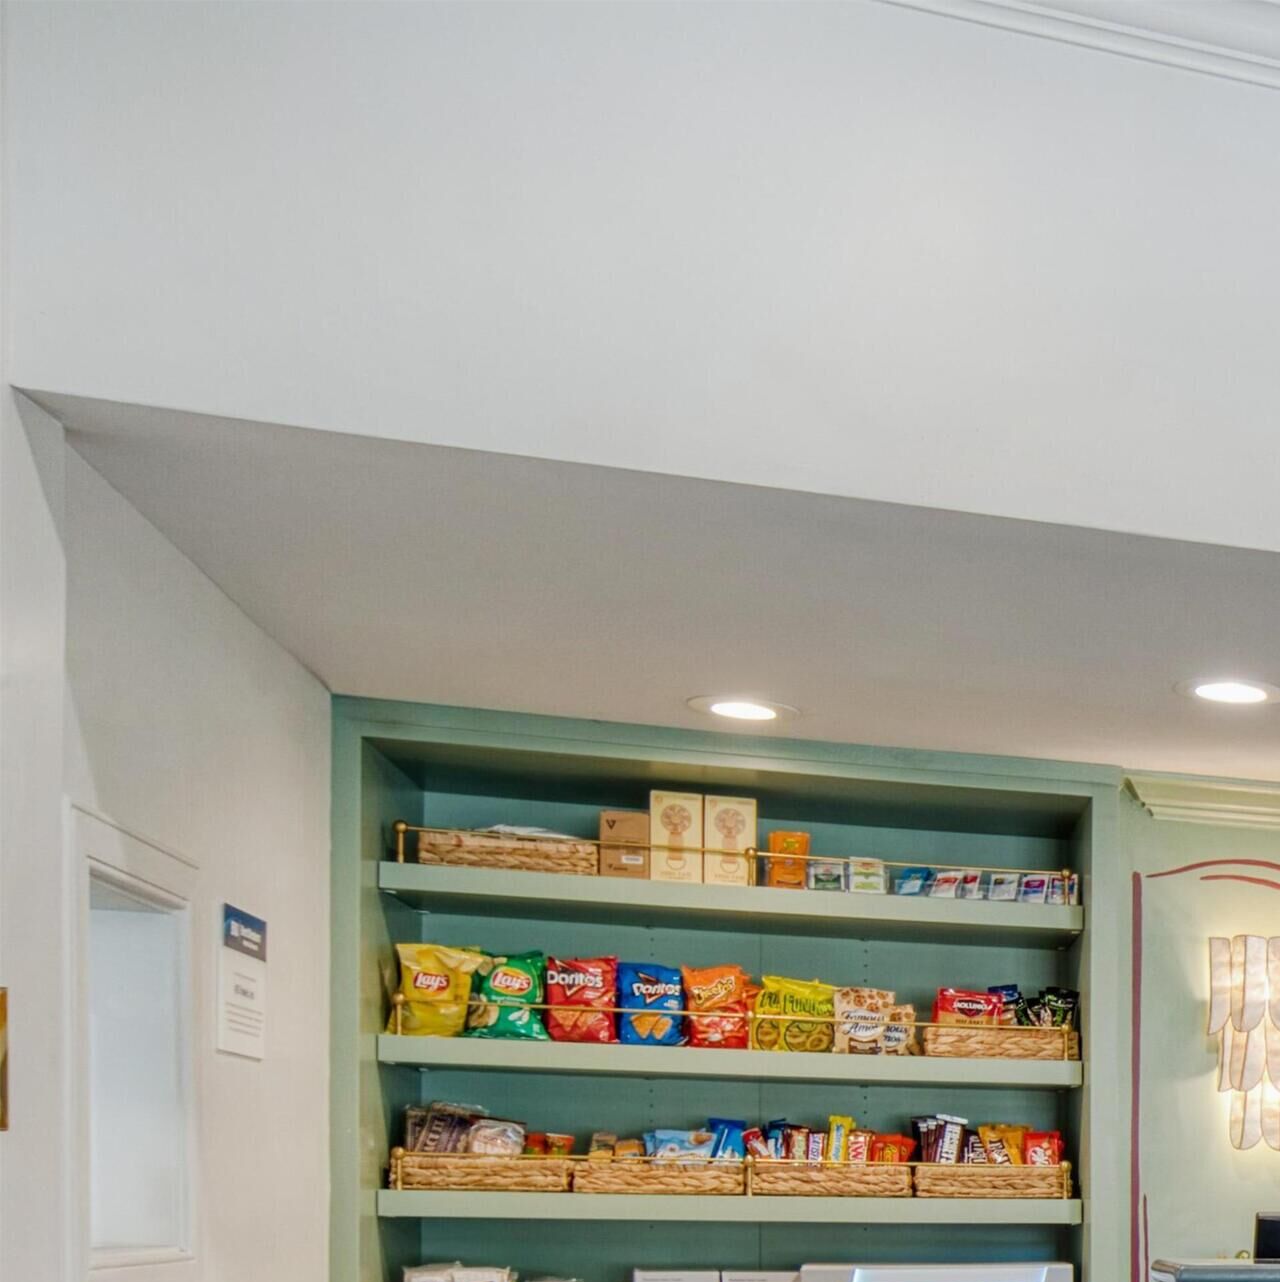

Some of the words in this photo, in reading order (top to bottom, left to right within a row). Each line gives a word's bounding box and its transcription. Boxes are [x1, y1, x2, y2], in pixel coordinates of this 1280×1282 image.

[415, 973, 449, 992] Lay's
[493, 973, 531, 989] Lay's
[547, 970, 603, 987] Doritos
[632, 983, 681, 996] Doritos
